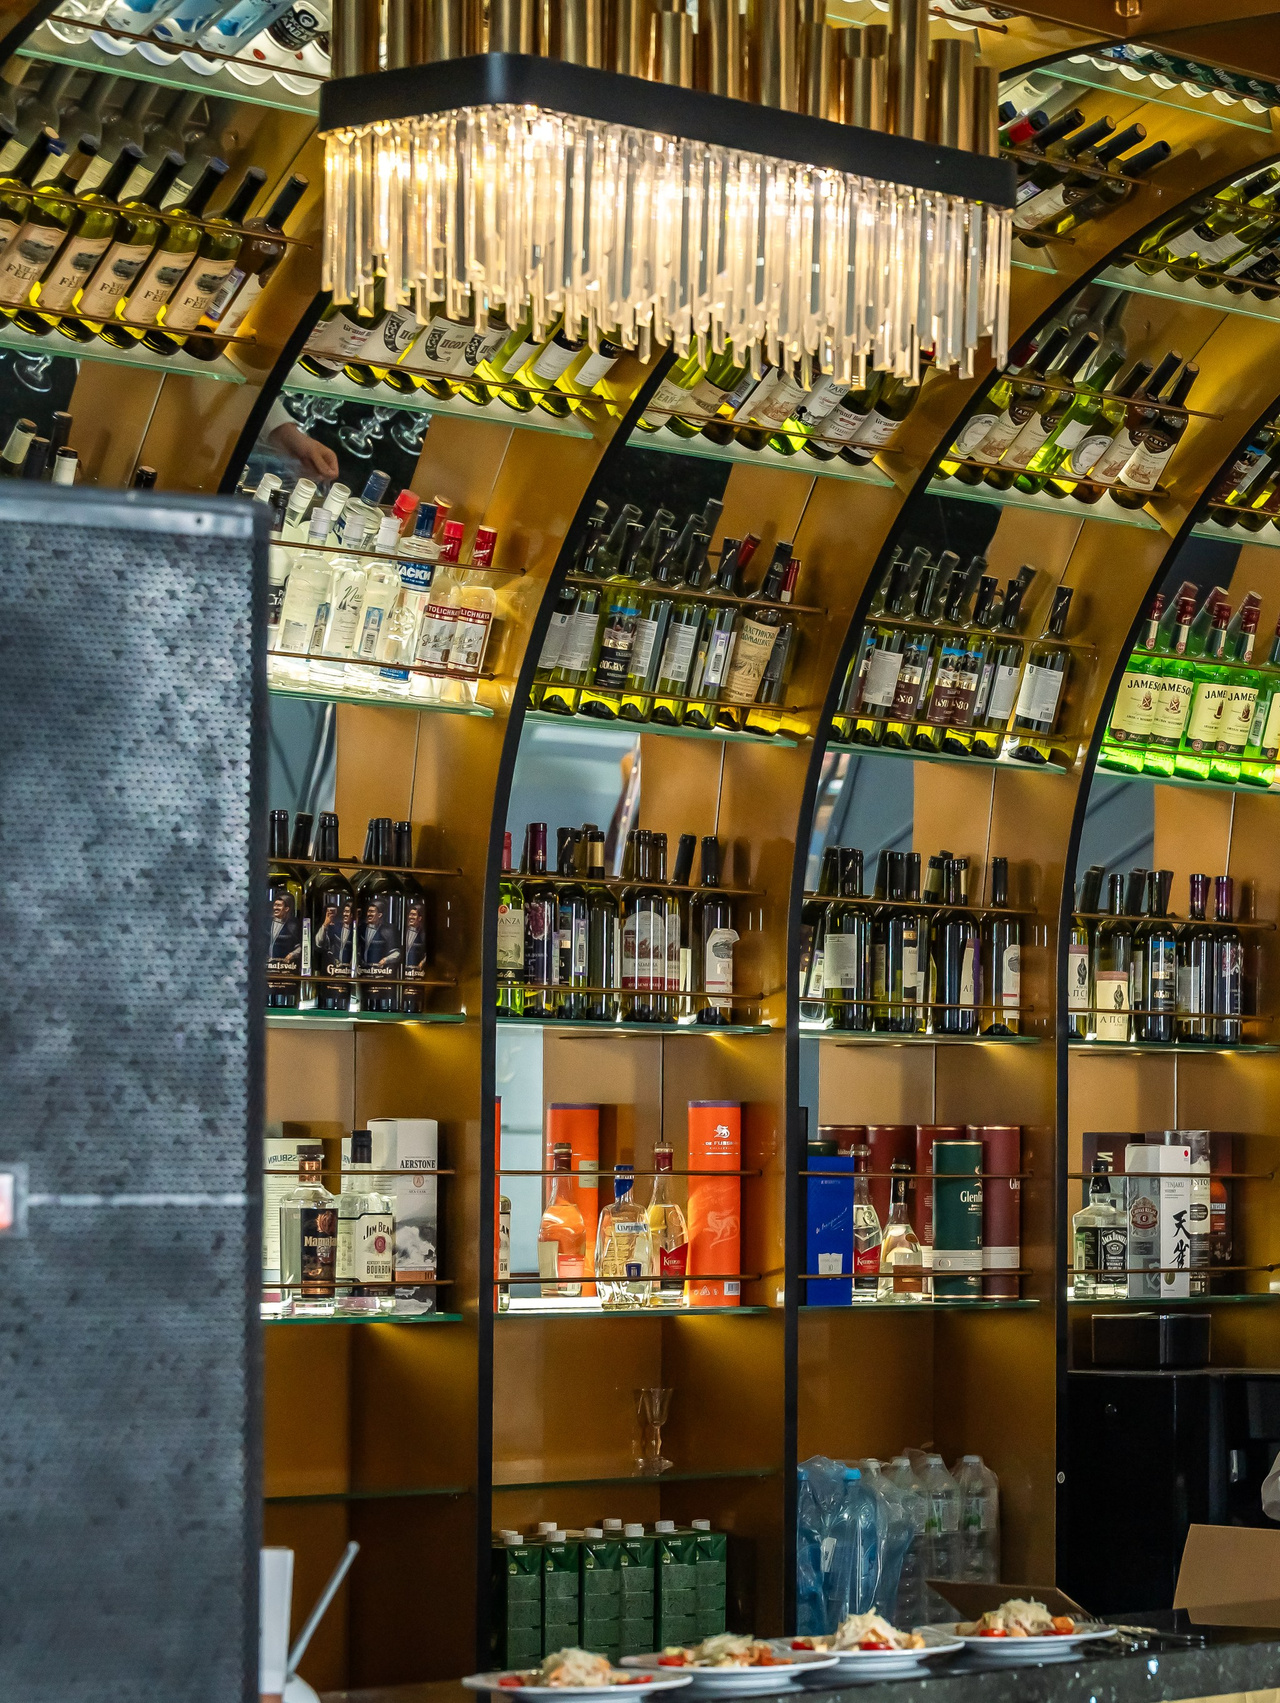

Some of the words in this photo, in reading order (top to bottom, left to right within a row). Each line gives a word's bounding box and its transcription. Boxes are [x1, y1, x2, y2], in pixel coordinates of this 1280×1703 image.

[461, 609, 490, 619] LICHNAYA
[1127, 679, 1161, 691] JAMESO
[1160, 680, 1191, 696] AMESO
[1205, 689, 1227, 700] JAME
[1228, 690, 1256, 702] JAMES
[400, 1160, 436, 1169] AERSTONE
[960, 1190, 982, 1203] Glenfi
[363, 1225, 377, 1240] JIM
[1112, 1233, 1127, 1245] DANIEL
[366, 1265, 391, 1274] BOURBON
